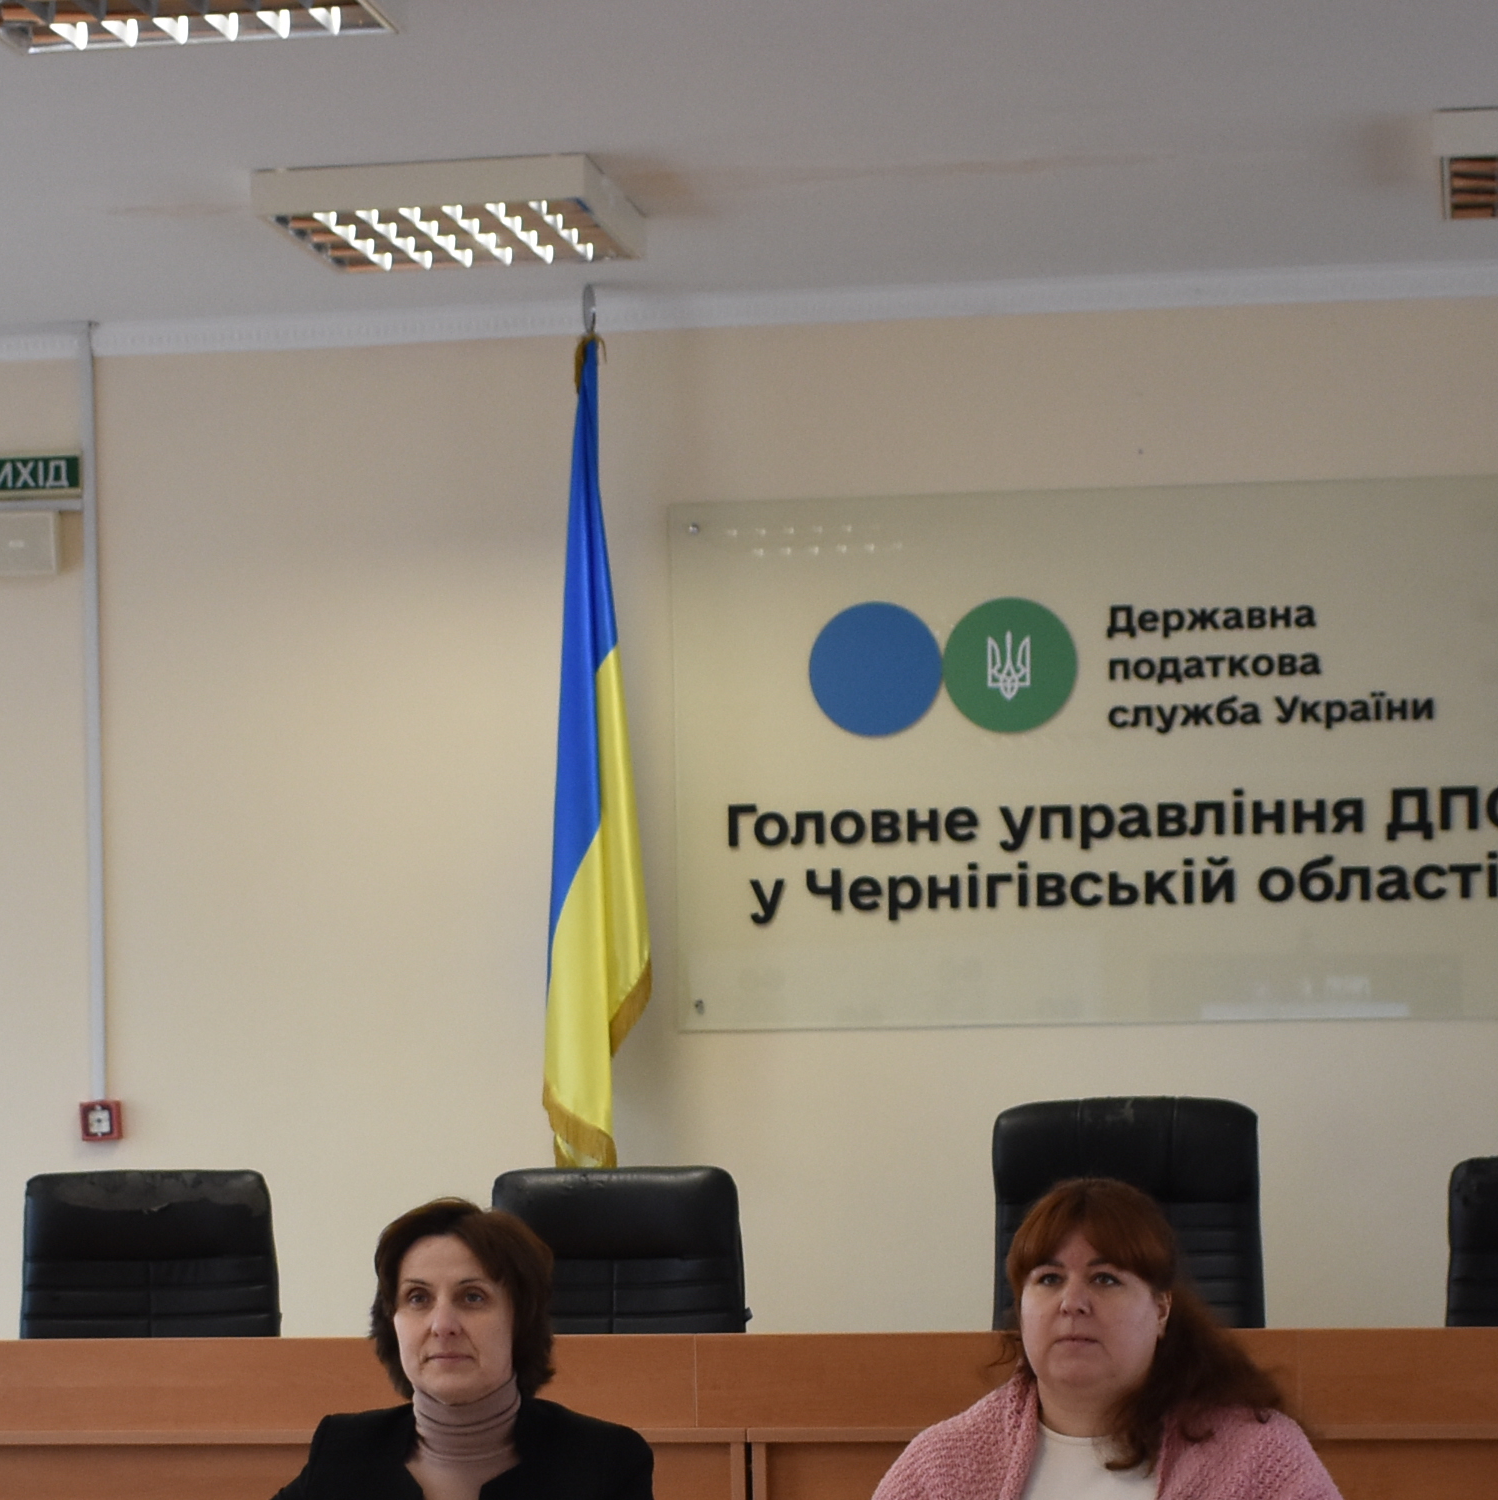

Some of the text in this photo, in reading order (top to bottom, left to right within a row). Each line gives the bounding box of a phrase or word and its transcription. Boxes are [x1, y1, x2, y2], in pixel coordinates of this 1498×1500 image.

[1107, 604, 1316, 638] Державна
[1108, 652, 1321, 683] податкова
[1108, 690, 1435, 733] служба України
[727, 803, 979, 848] Головне
[999, 787, 1364, 851] управління
[749, 850, 1498, 925] у Чернігівській області
